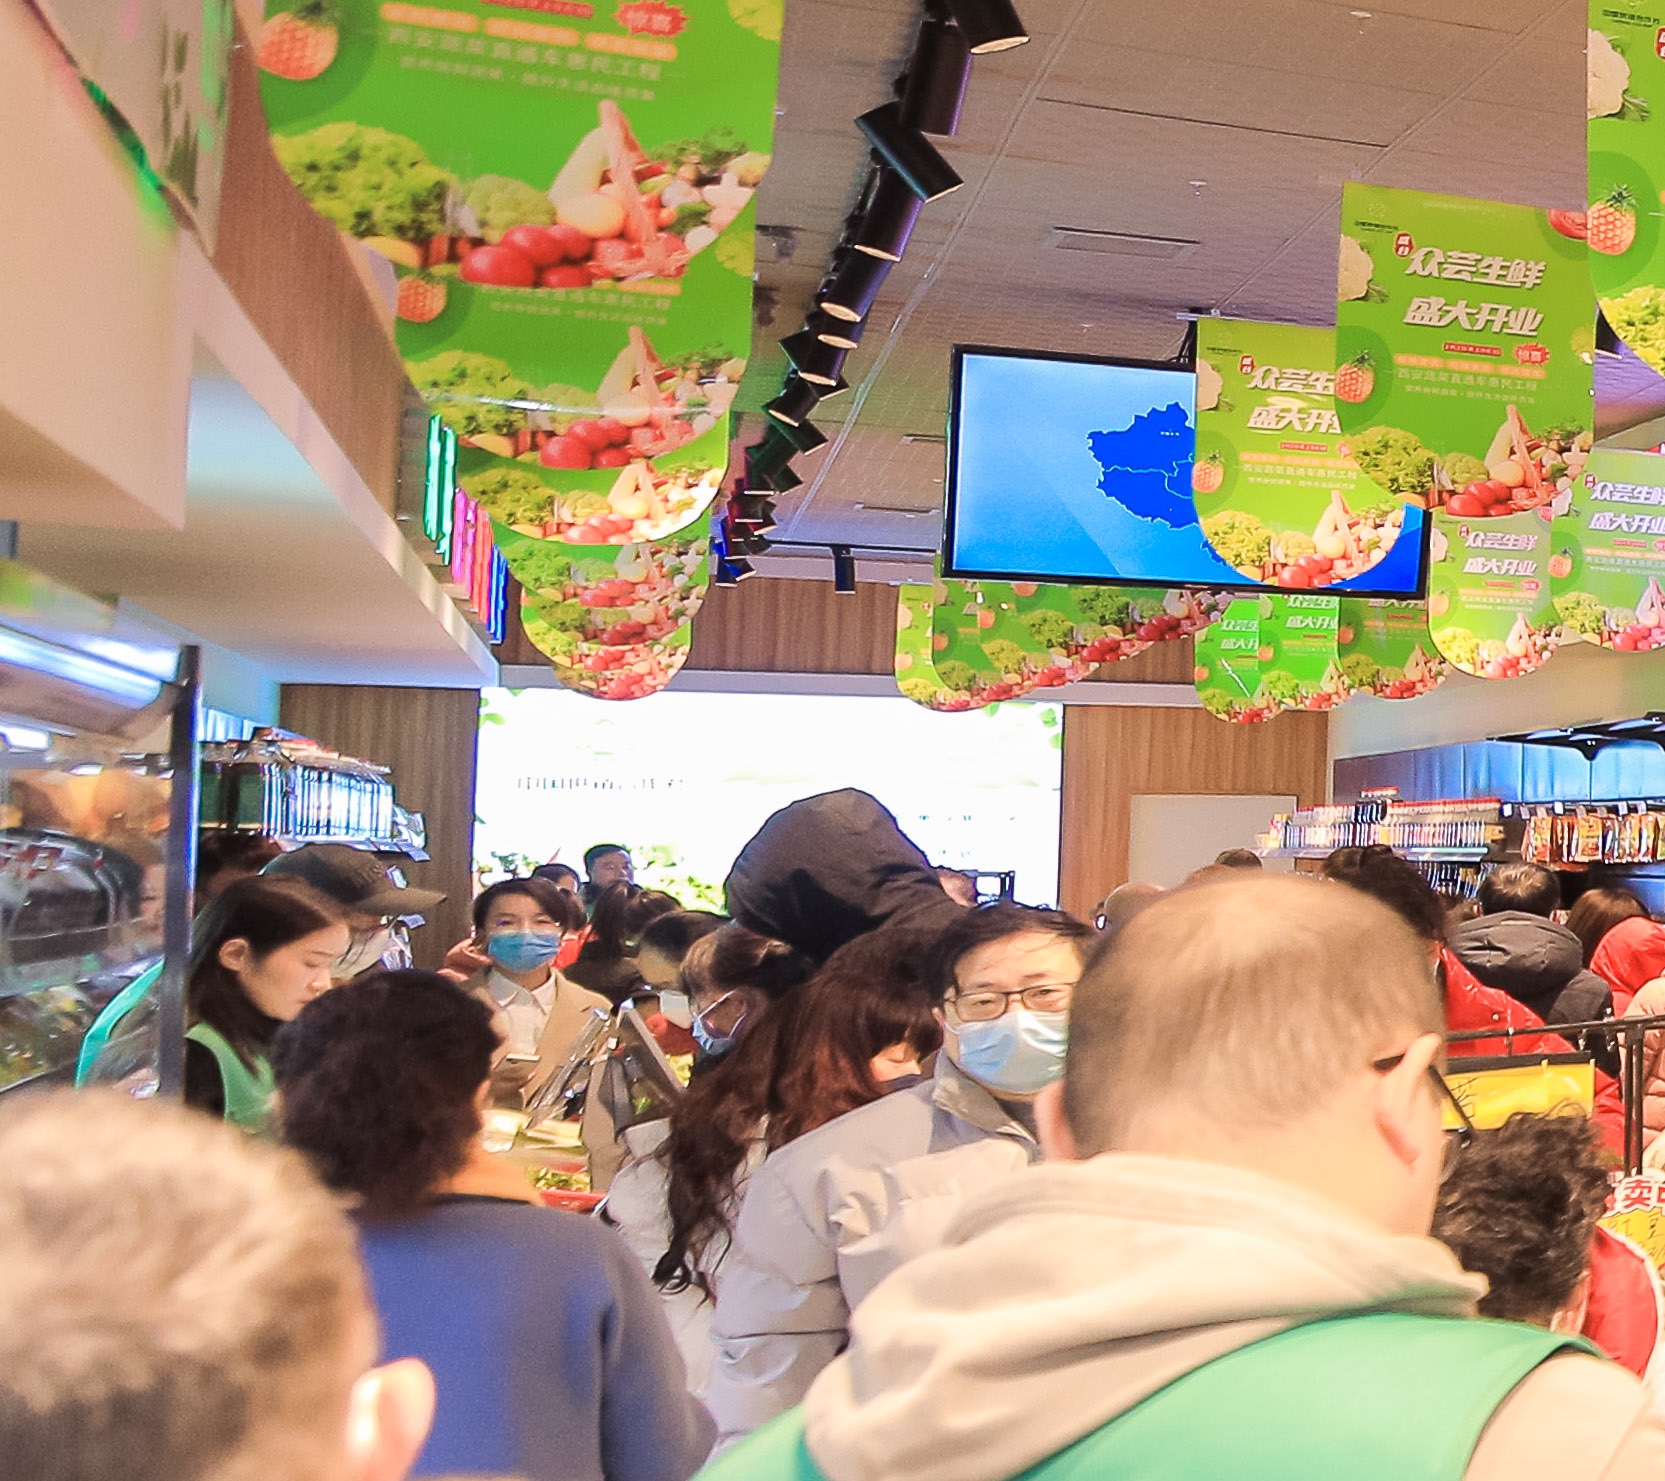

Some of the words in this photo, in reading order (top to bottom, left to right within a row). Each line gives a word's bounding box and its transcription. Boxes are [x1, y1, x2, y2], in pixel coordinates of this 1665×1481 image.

[1404, 247, 1546, 288] 众芸生鲜
[1403, 296, 1544, 336] 盛大开业
[1247, 366, 1336, 395] 众芸生
[1464, 531, 1538, 552] 众芸生鲜
[1463, 557, 1537, 576] 盛大开业
[1220, 620, 1260, 632] 众芸生
[1220, 637, 1259, 650] 盛大开
